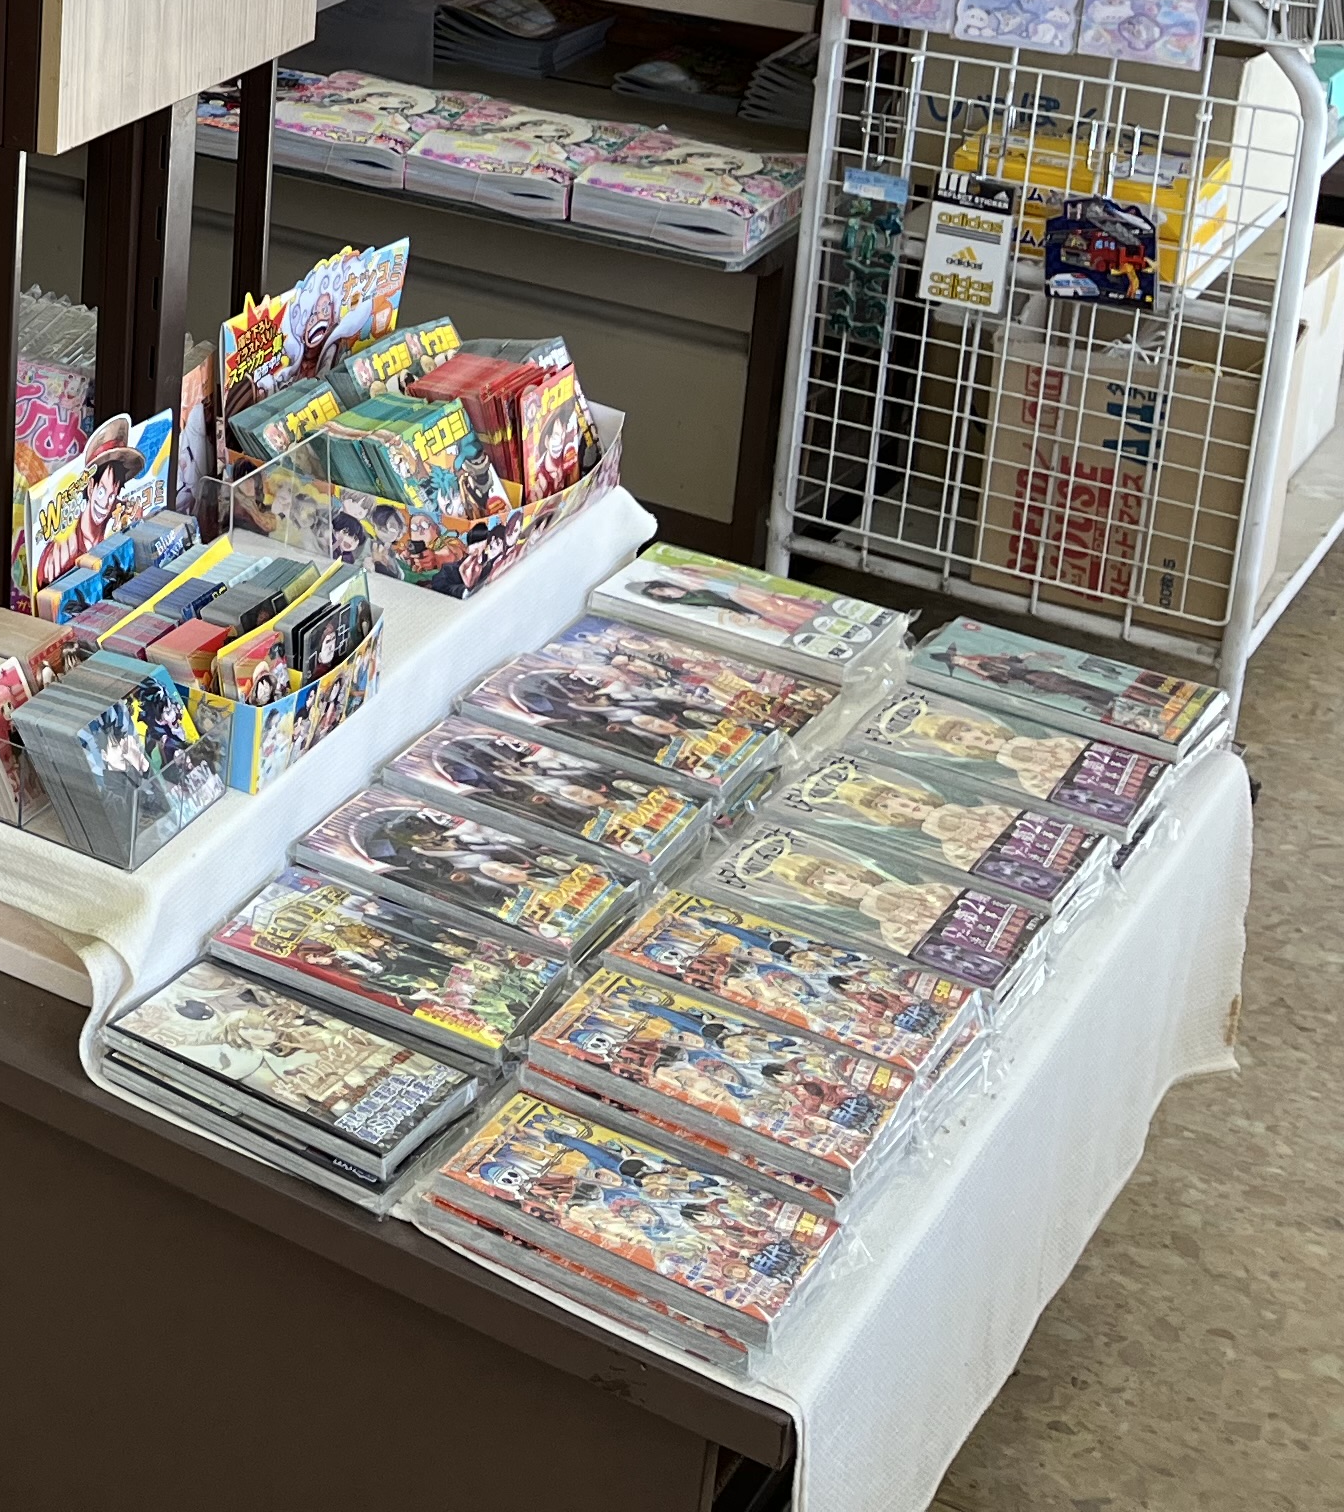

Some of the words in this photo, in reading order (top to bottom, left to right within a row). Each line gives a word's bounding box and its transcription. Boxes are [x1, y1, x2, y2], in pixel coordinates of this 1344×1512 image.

[938, 211, 1004, 234] adidas
[946, 257, 983, 271] adidas
[930, 272, 994, 292] adidas
[928, 285, 992, 306] adidas
